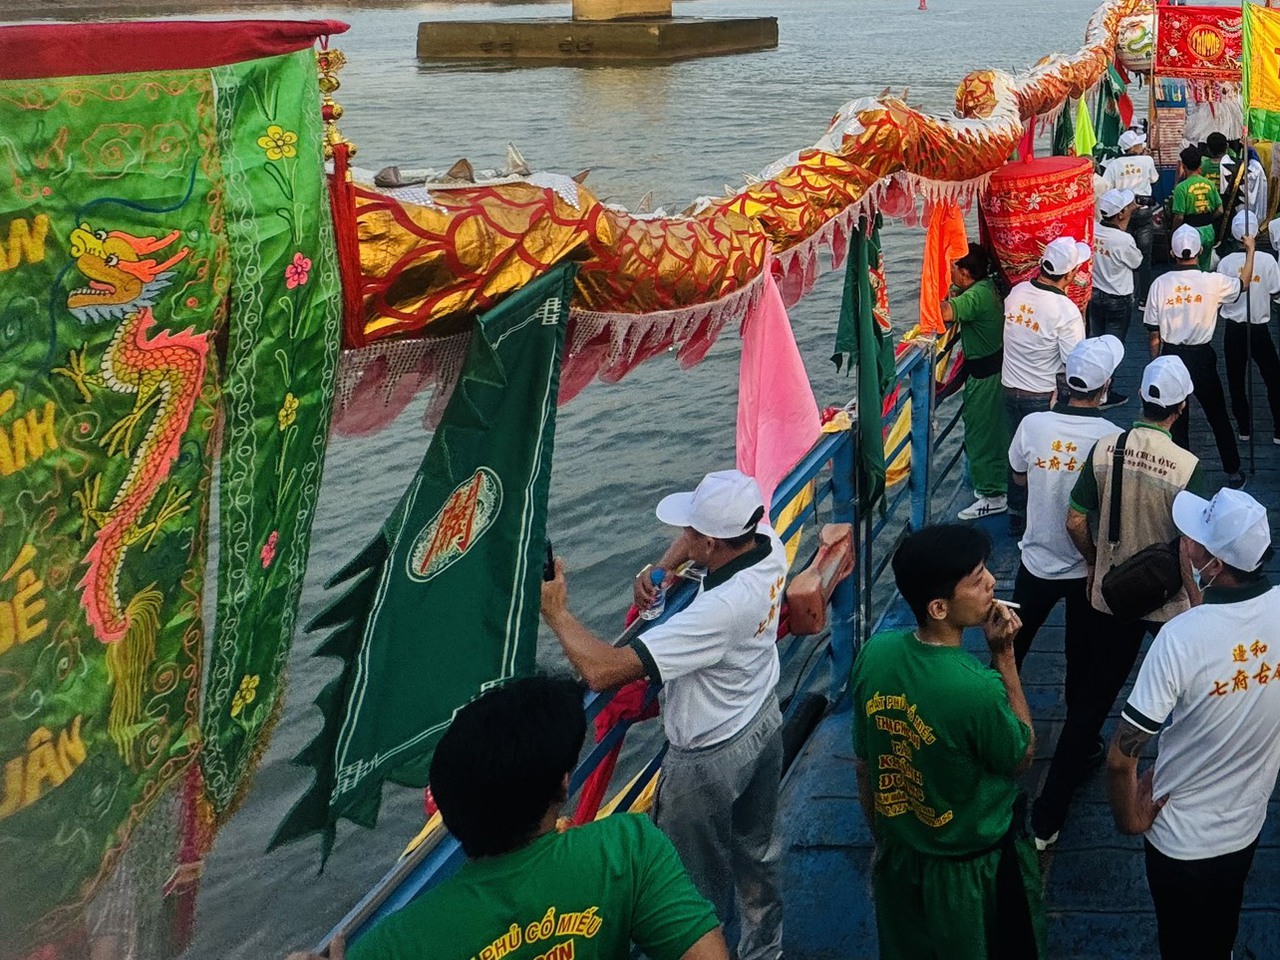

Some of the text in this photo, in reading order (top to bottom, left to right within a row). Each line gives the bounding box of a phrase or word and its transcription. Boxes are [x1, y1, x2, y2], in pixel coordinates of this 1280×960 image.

[480, 906, 603, 960] PHỦ CỔ MIẾU
